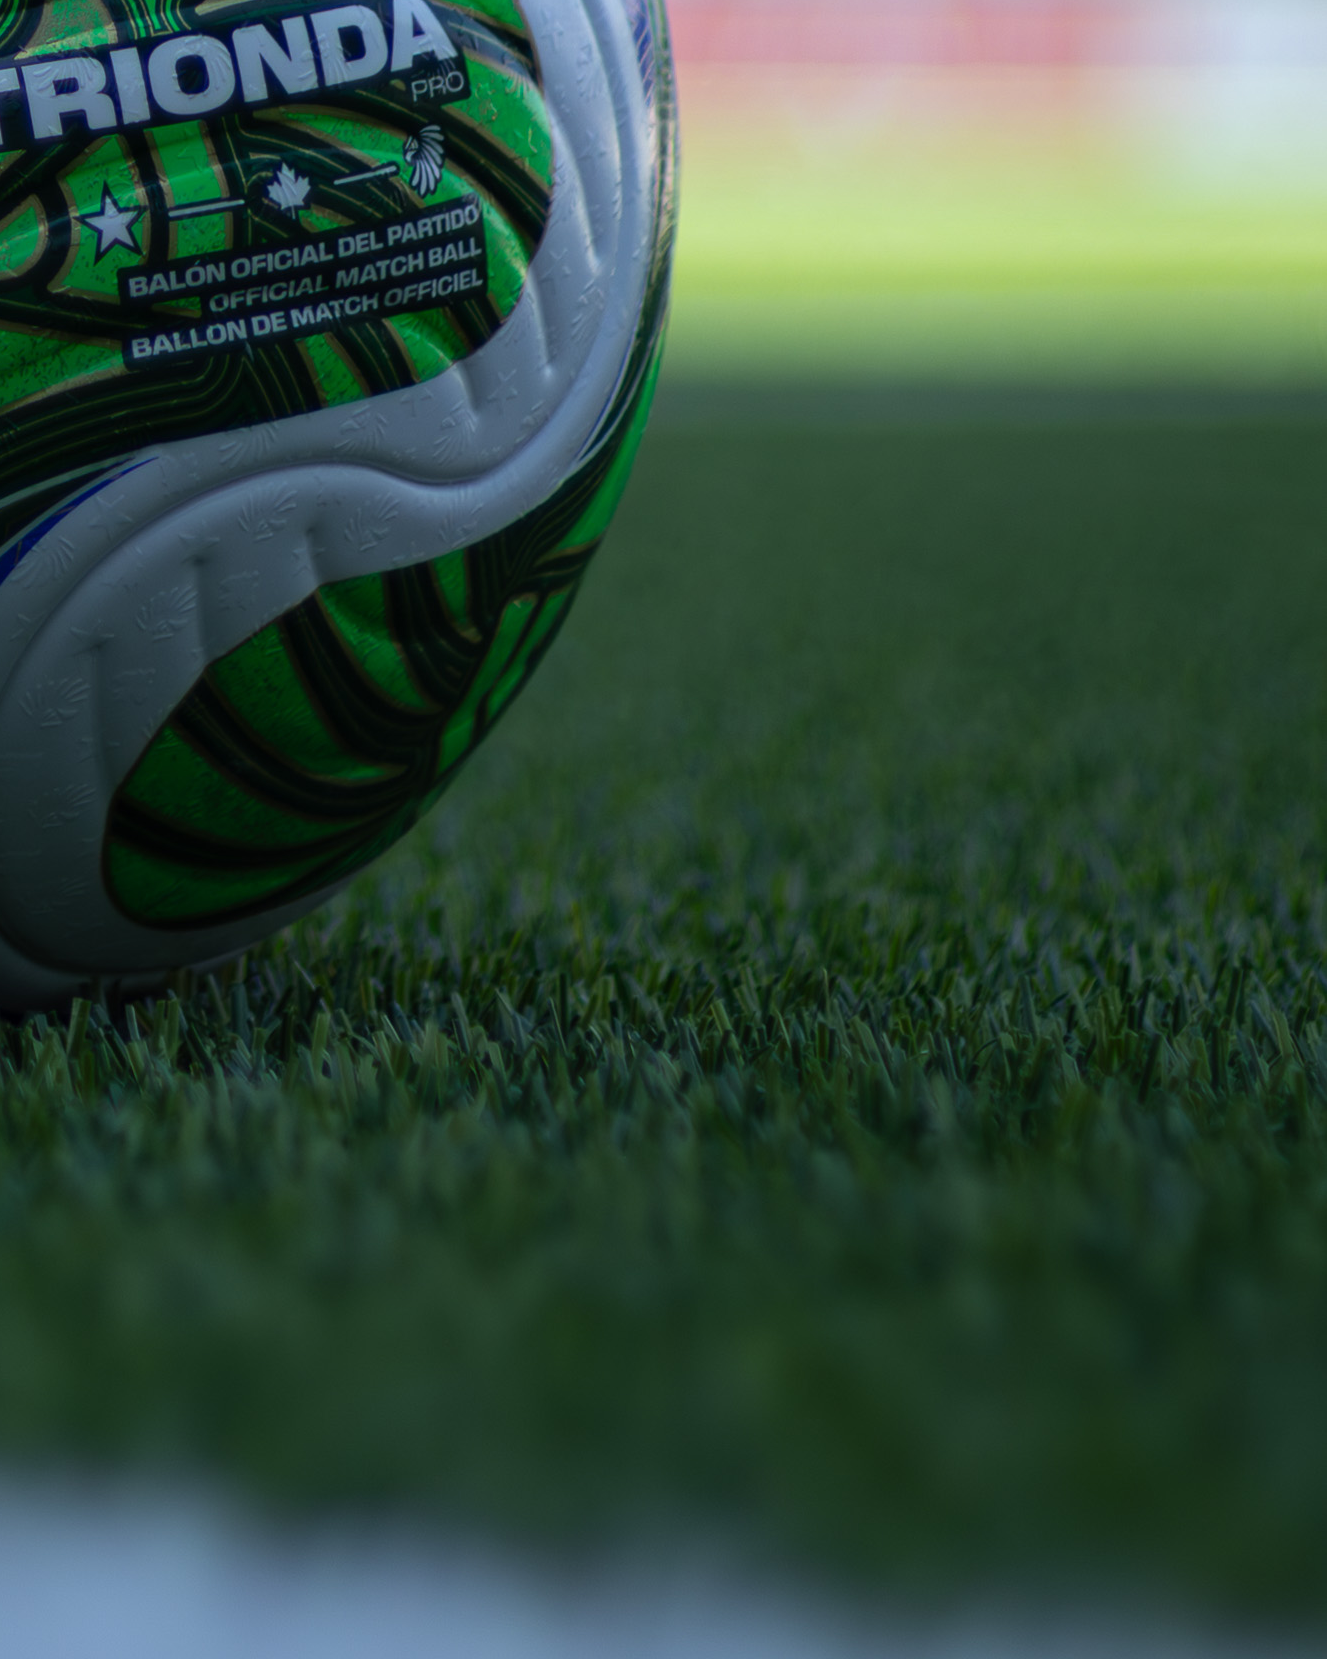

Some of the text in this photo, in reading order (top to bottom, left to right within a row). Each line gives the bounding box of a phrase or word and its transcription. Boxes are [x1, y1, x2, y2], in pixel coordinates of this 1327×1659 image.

[411, 71, 464, 102] PRO
[129, 203, 479, 298] BALÓN OFICIAL DEL PARTIDO
[209, 237, 482, 312] OFFICIAL MATCH BALL
[131, 268, 483, 358] BALLON DE MATCH OFFICIEL
